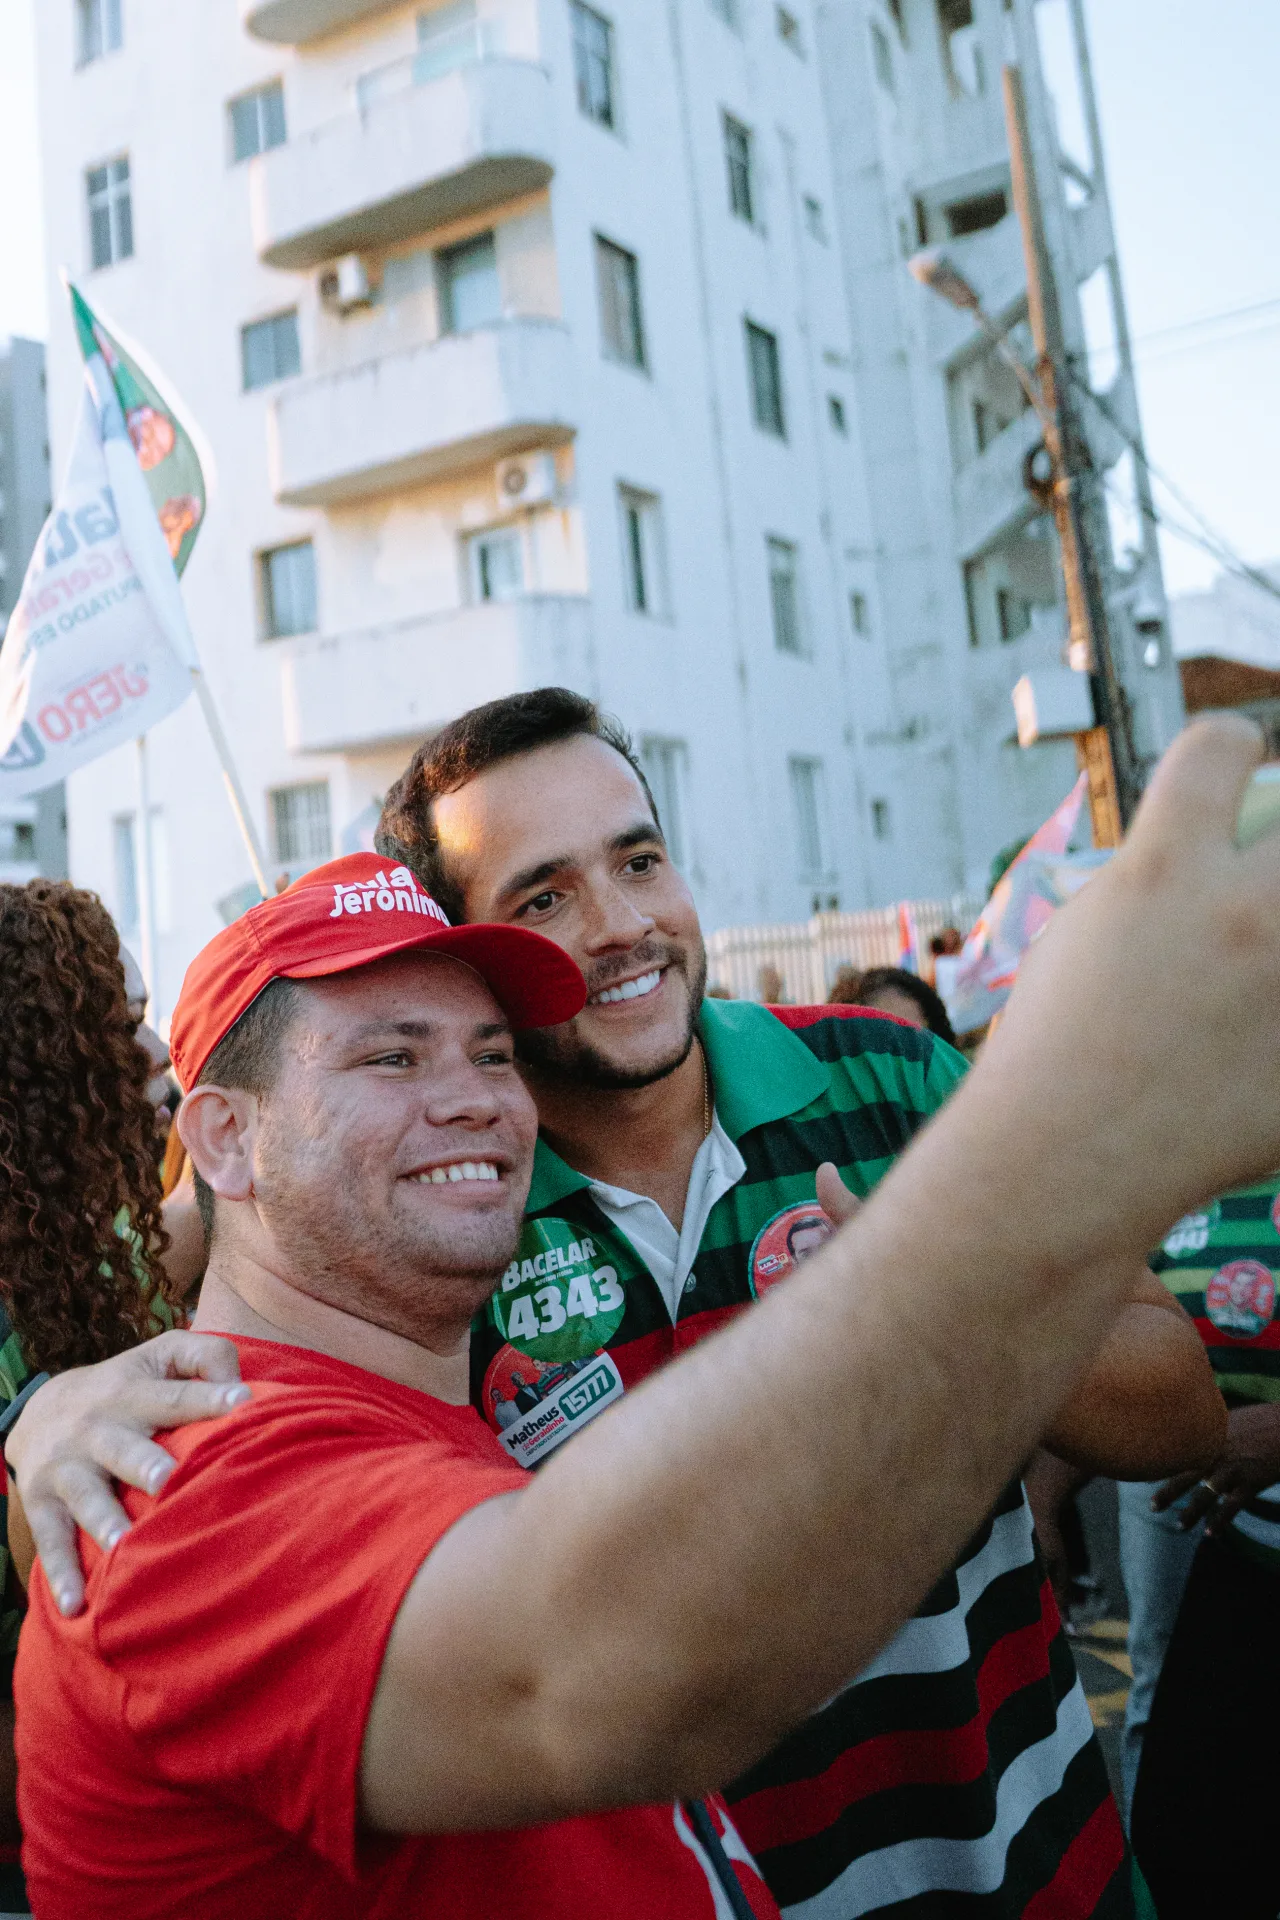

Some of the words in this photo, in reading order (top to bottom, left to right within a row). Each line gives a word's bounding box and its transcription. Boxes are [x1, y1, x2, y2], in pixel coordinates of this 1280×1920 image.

[501, 1238, 597, 1292] BACELAR
[507, 1265, 625, 1341] 4343
[561, 1369, 610, 1415] 15777
[506, 1406, 560, 1450] Matheus
[528, 1416, 565, 1446] Geraldinho
